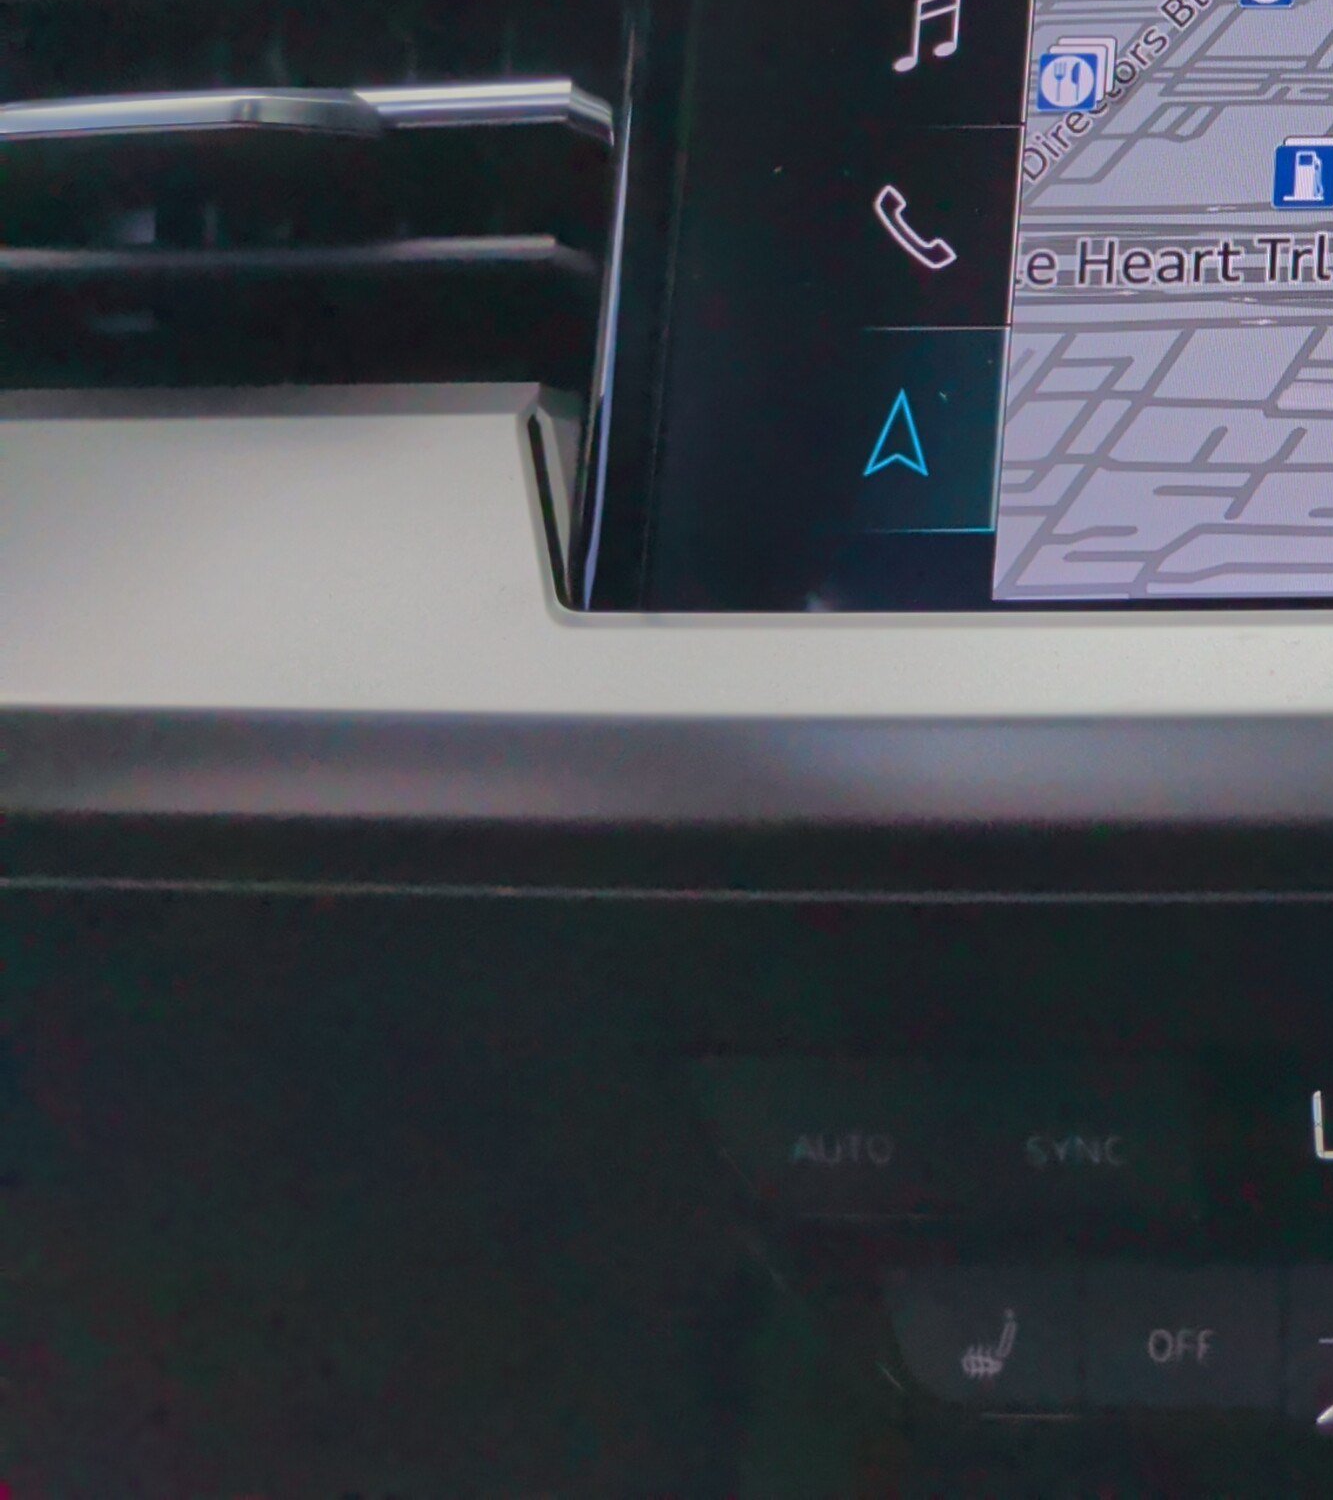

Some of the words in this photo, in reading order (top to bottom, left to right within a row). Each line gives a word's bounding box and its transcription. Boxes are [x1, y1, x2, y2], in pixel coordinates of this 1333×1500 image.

[1078, 240, 1241, 285] Heart
[1257, 233, 1331, 282] Trl
[790, 1132, 893, 1167] AUTO
[1025, 1133, 1124, 1167] SYNC
[1147, 1327, 1214, 1365] OFF
